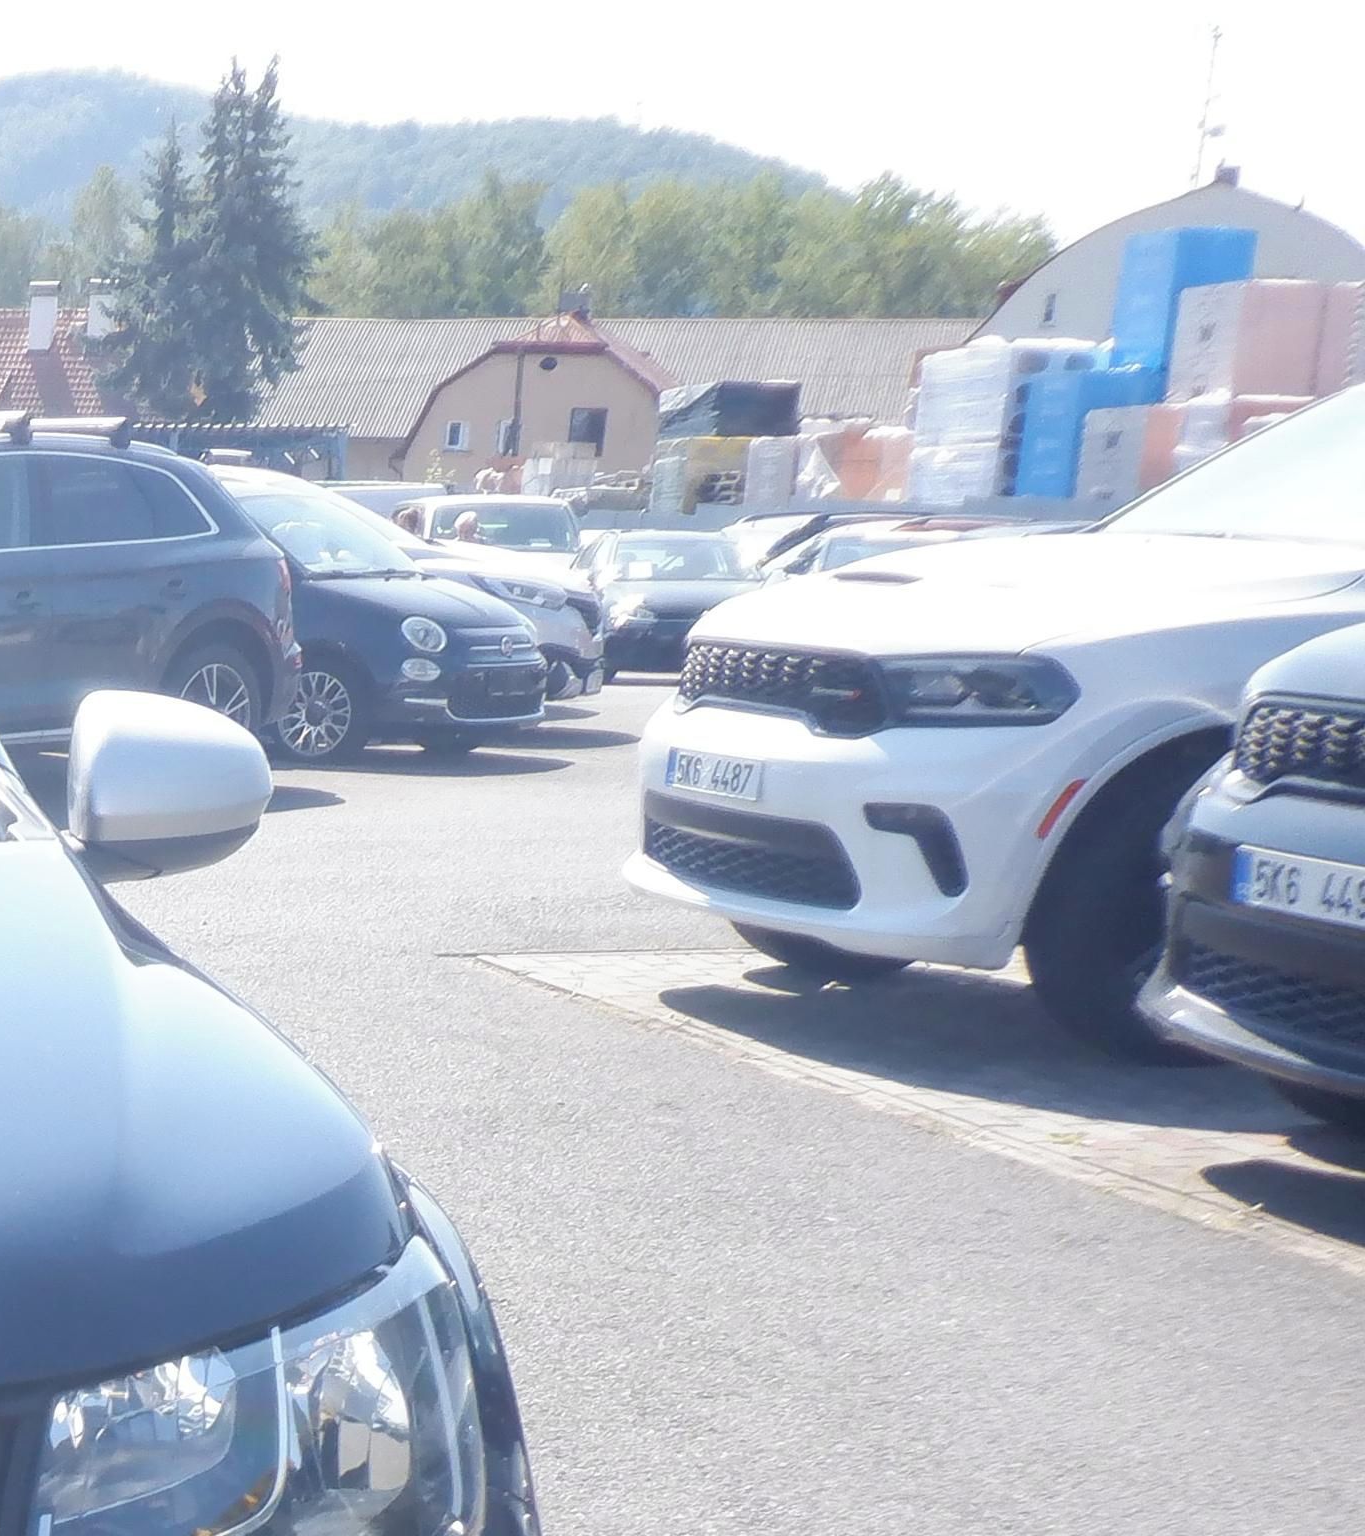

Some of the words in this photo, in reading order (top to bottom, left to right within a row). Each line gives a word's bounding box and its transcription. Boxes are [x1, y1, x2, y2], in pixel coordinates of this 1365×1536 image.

[677, 754, 702, 785] 5K6
[711, 759, 754, 793] 4487
[1255, 860, 1302, 905] 5K6
